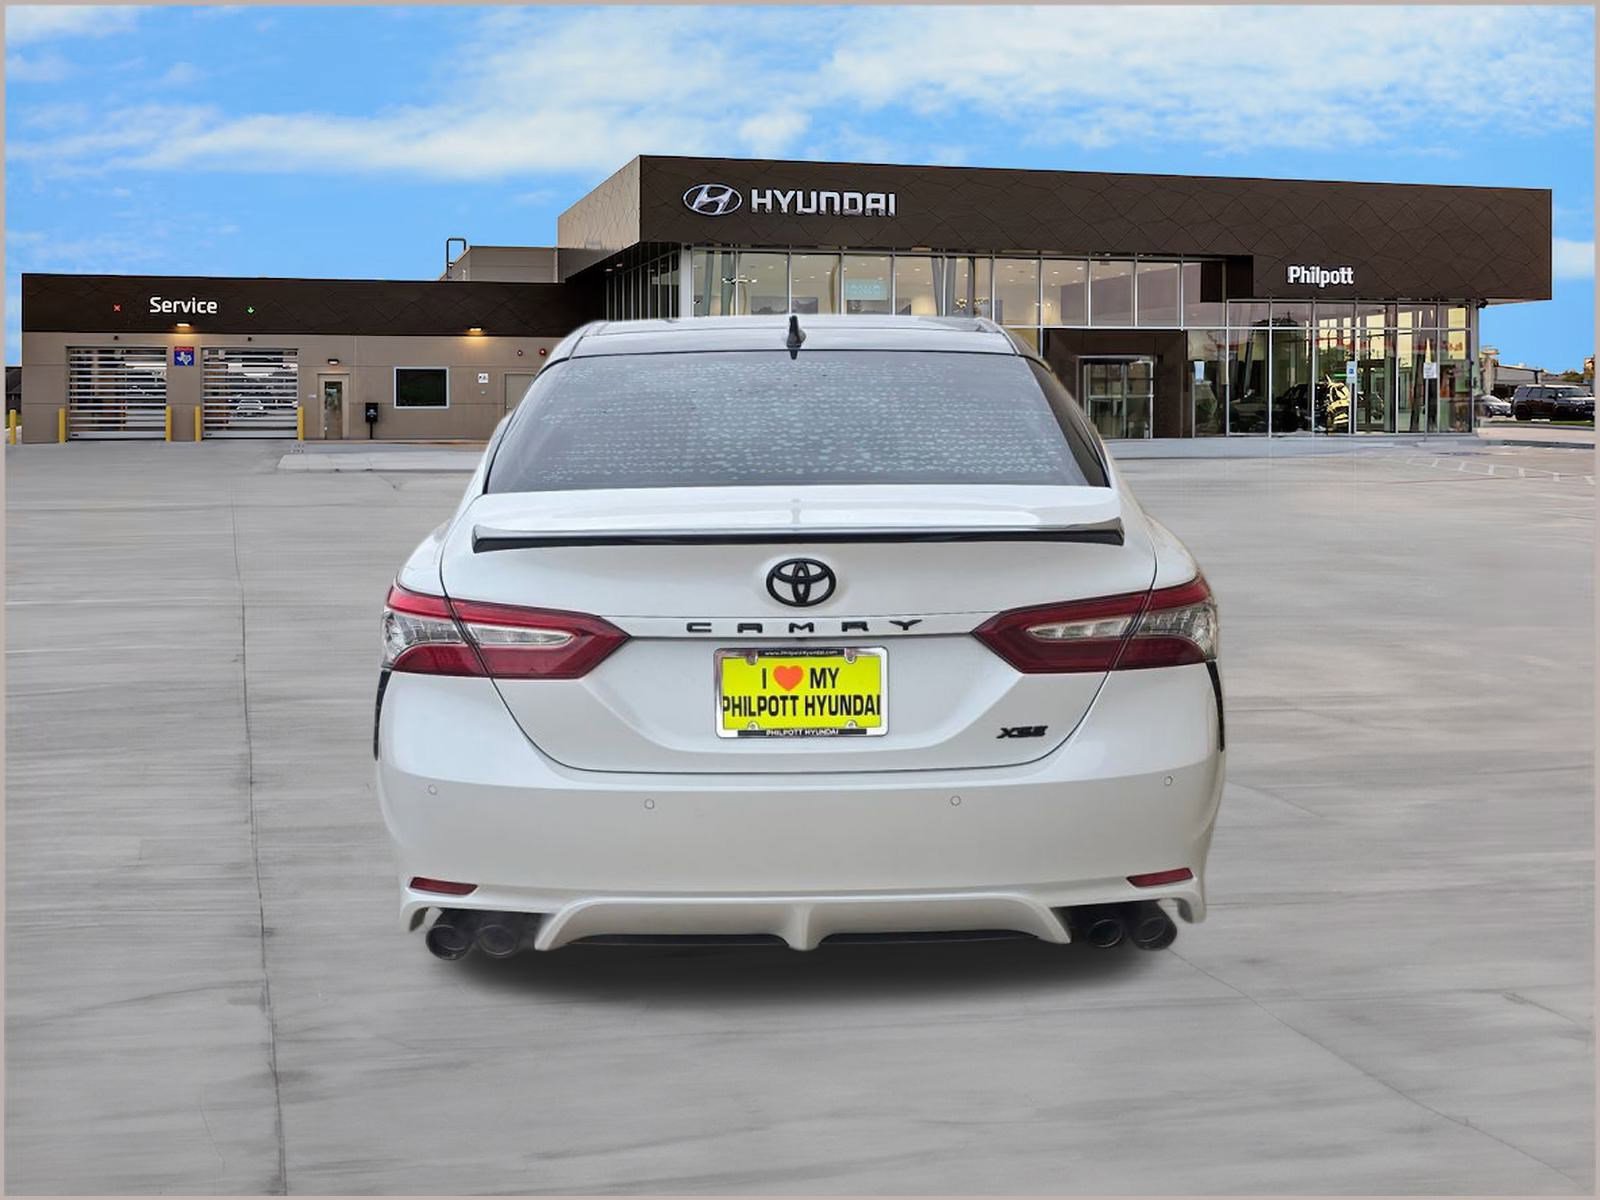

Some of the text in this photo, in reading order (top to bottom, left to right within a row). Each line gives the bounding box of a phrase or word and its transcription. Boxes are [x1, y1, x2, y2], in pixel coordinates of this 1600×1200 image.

[751, 189, 896, 216] HYUNDAI
[1287, 265, 1354, 288] Philpott
[149, 297, 218, 314] Service
[686, 619, 923, 634] CAMRY
[762, 668, 839, 689] I MY
[723, 694, 880, 717] PHILPOTT HYUNDAI
[805, 728, 838, 736] HYUNDAI
